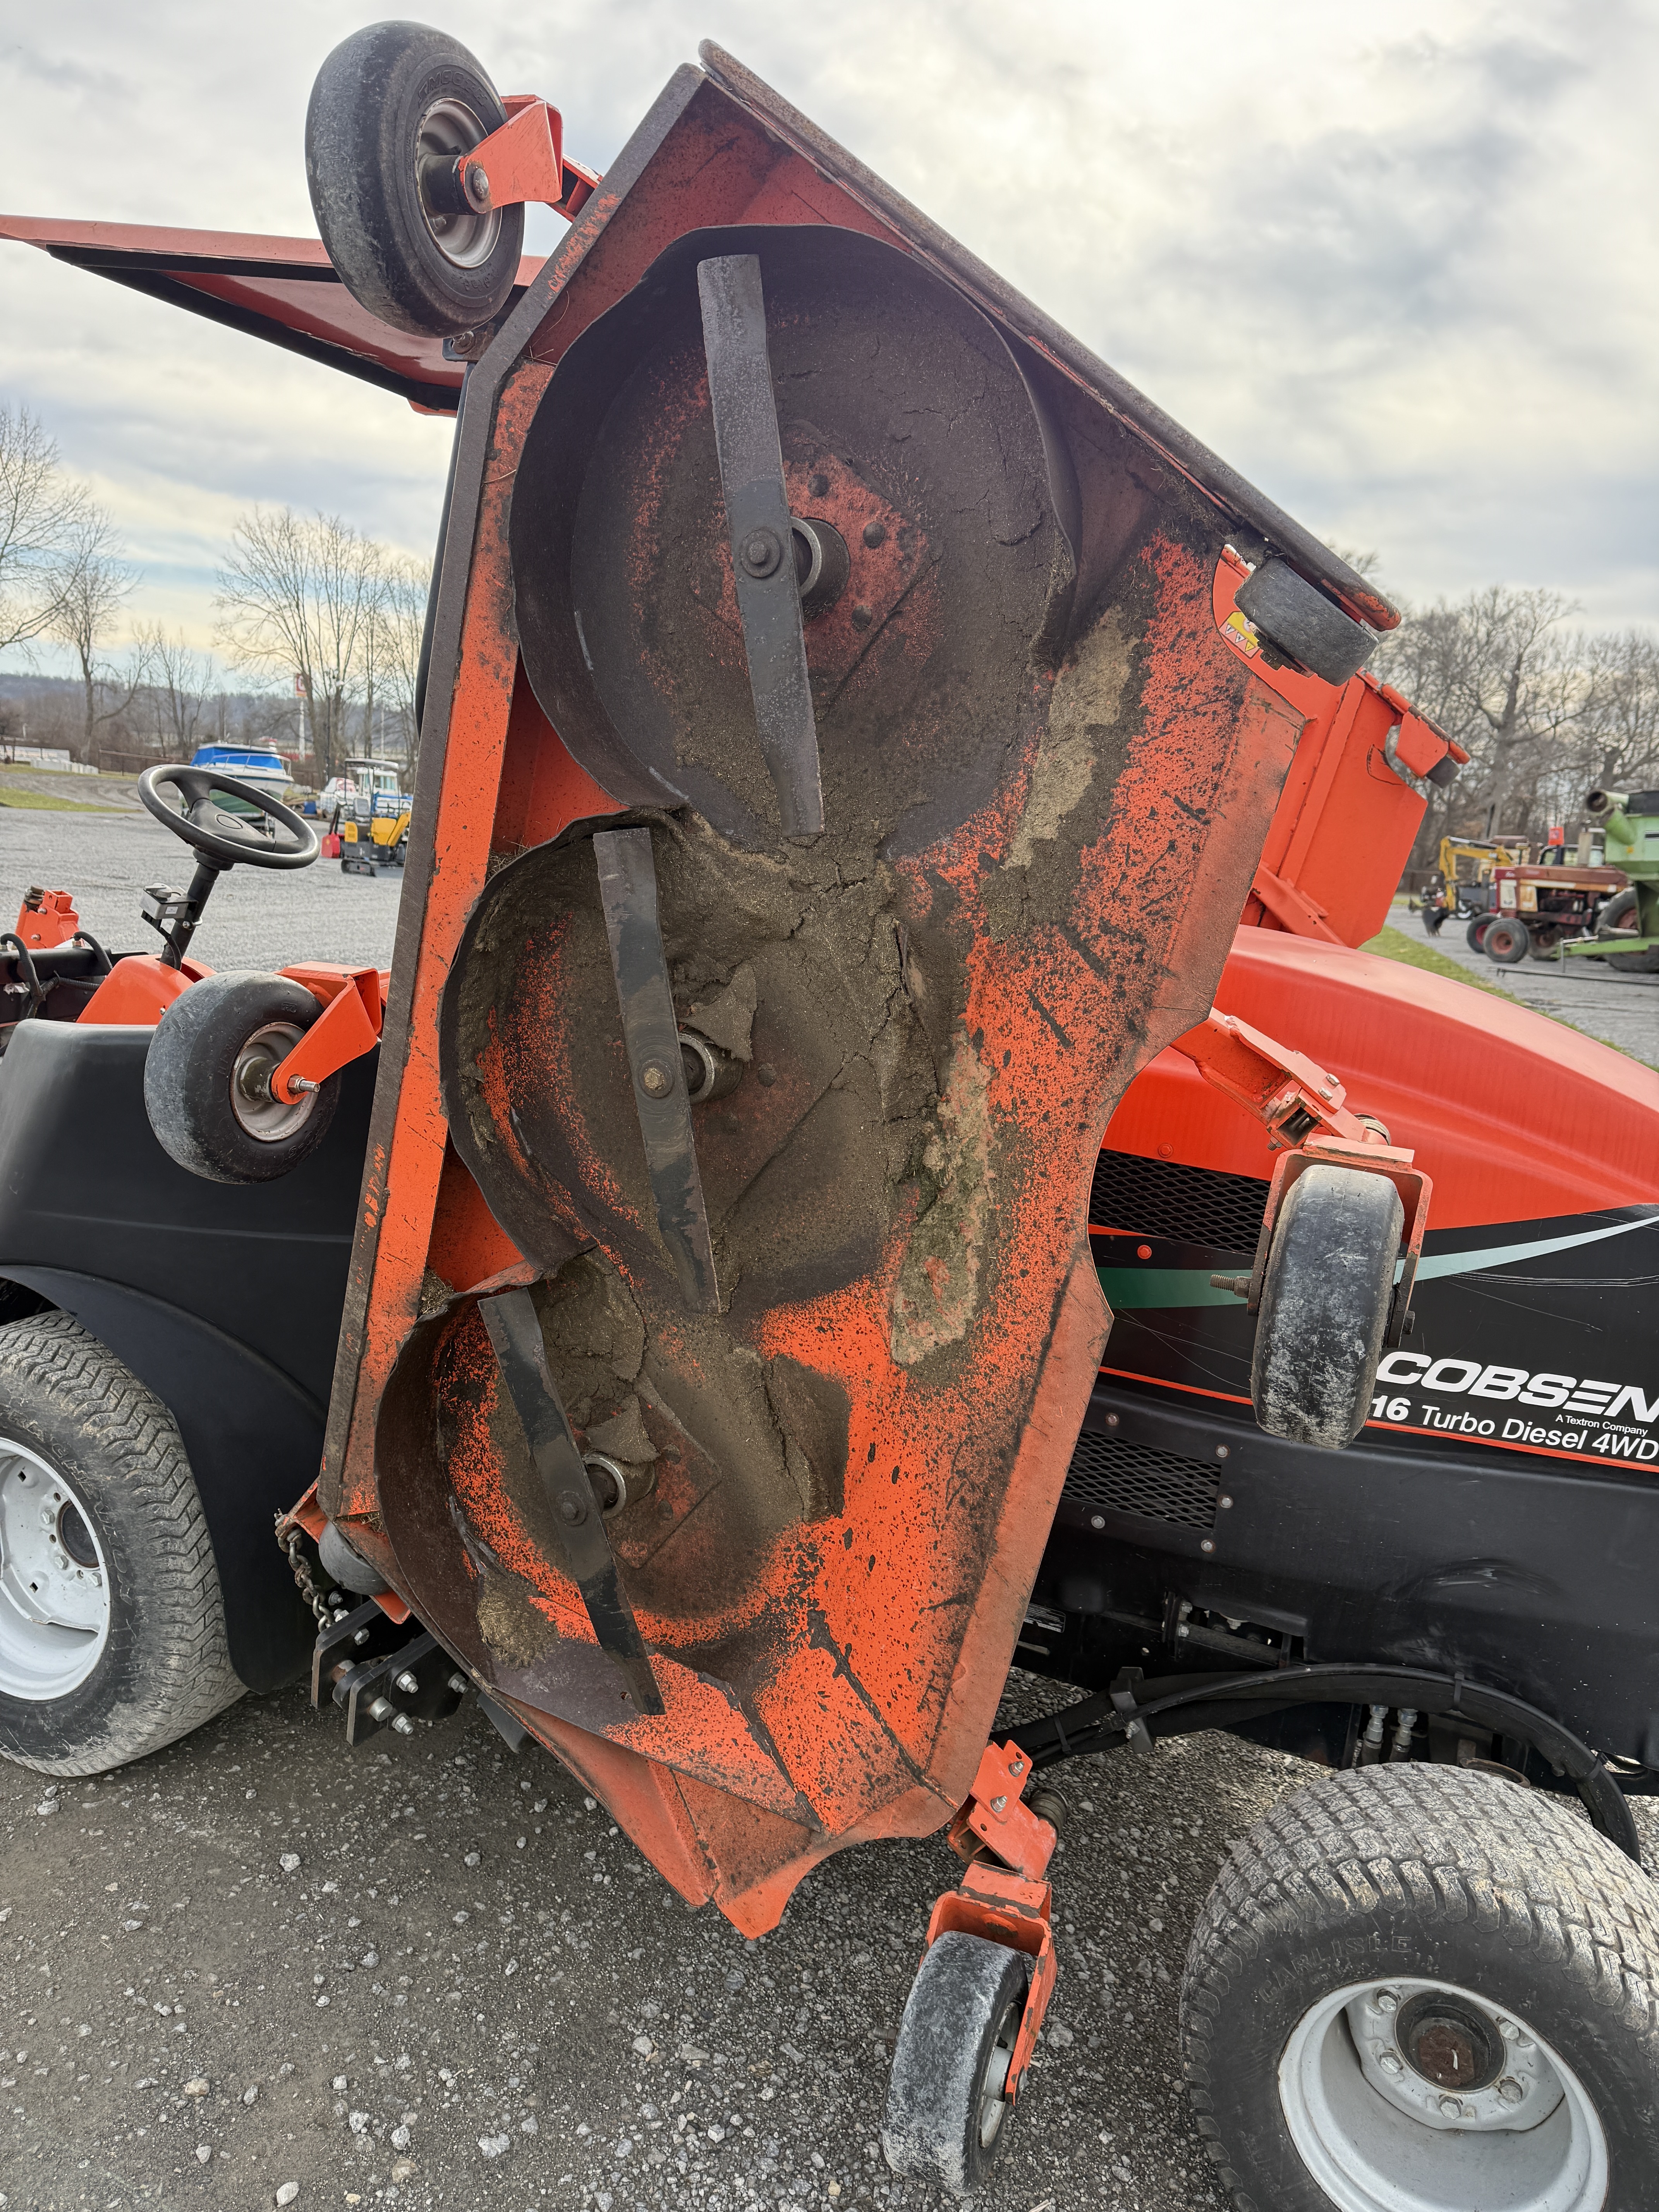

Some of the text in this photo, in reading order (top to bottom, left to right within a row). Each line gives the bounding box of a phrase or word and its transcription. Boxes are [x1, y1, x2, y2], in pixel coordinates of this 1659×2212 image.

[1372, 1395, 1659, 1460] 16 Turbo Diesel 4WD
[1556, 1414, 1648, 1437] A Textron Company
[1258, 1936, 1412, 2003] CARLISLE
